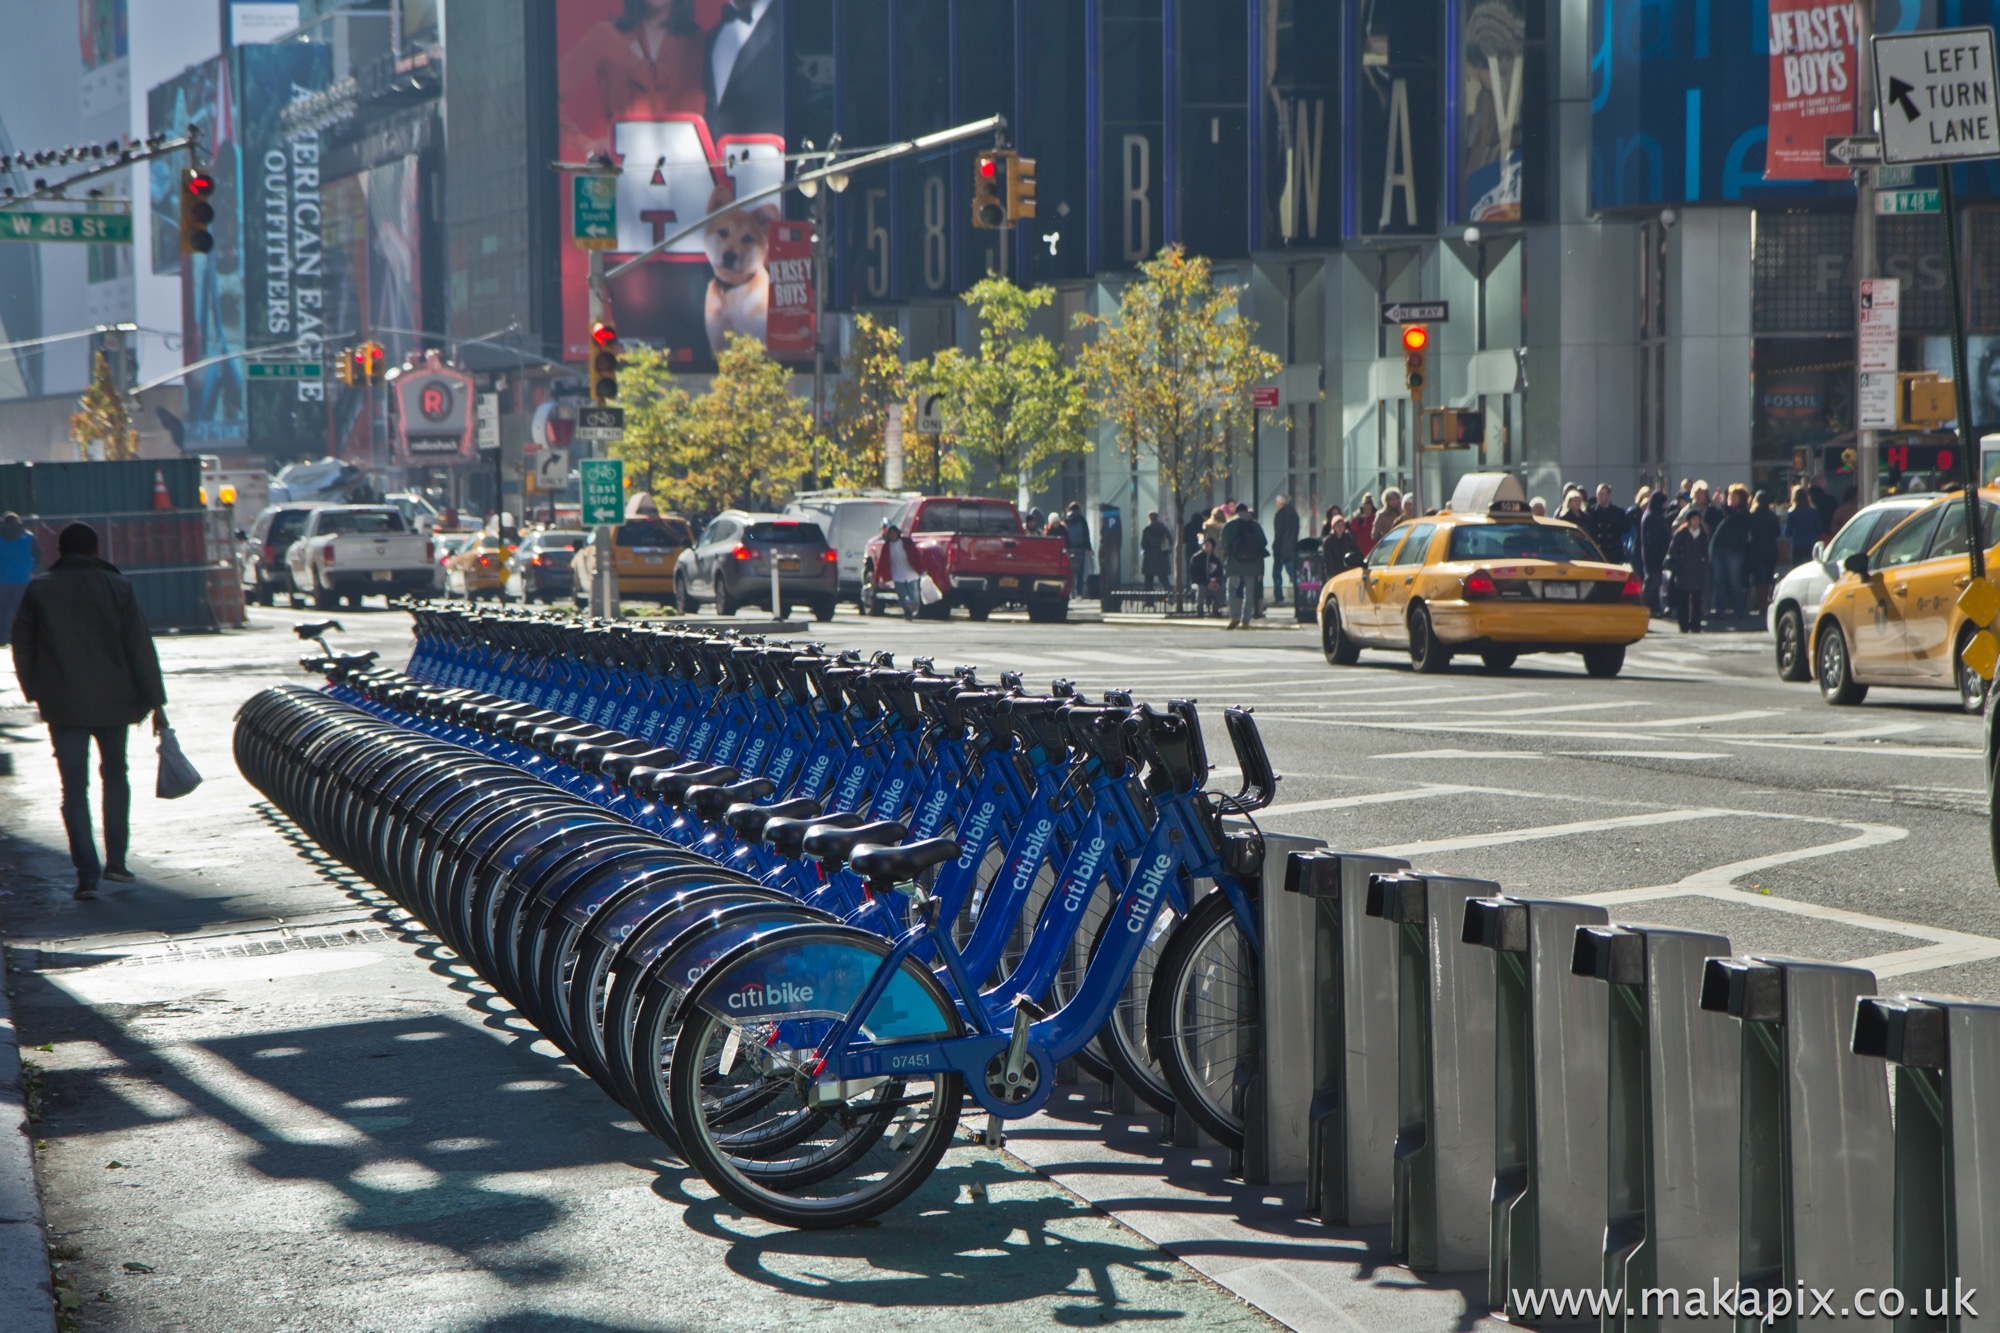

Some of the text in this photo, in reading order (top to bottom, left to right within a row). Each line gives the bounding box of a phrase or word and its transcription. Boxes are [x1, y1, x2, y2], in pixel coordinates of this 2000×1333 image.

[1769, 4, 1855, 56] JERSEY
[1924, 46, 1981, 75] LEFT
[1784, 51, 1848, 99] BOYS
[1925, 80, 1988, 109] TURN
[1929, 116, 1990, 145] LANE
[1838, 146, 1863, 158] ONE
[1899, 194, 1909, 211] W
[1910, 194, 1925, 212] 48
[12, 216, 107, 237] W 48 St
[264, 149, 290, 334] OUTFITTERS
[291, 82, 324, 402] AERICAN EAGE
[769, 258, 812, 284] JERSEY
[775, 283, 807, 307] BOYS
[1393, 306, 1440, 319] ONE WAY
[423, 388, 442, 414] R
[1764, 394, 1818, 407] FOSSIL
[923, 420, 943, 430] ONL
[589, 483, 616, 494] East
[589, 495, 616, 506] Side
[545, 688, 561, 711] bike
[562, 691, 578, 716] bike
[579, 695, 597, 722] bike
[598, 700, 616, 727] bike
[618, 705, 638, 731] bike
[641, 710, 660, 737] bike
[666, 716, 686, 744] bike
[694, 721, 711, 751] bike
[715, 730, 737, 760] bike
[742, 738, 765, 769] bike
[769, 747, 794, 779] bike
[804, 754, 829, 788] bike
[840, 765, 865, 801] bike
[878, 778, 904, 815] bike
[920, 790, 948, 828] bike
[958, 802, 995, 869] citi bike
[1013, 818, 1051, 890] citi bike
[1063, 837, 1105, 912] citi bike
[1126, 854, 1171, 933] citi bike
[728, 982, 814, 1009] citi bike
[892, 1053, 930, 1069] 07451
